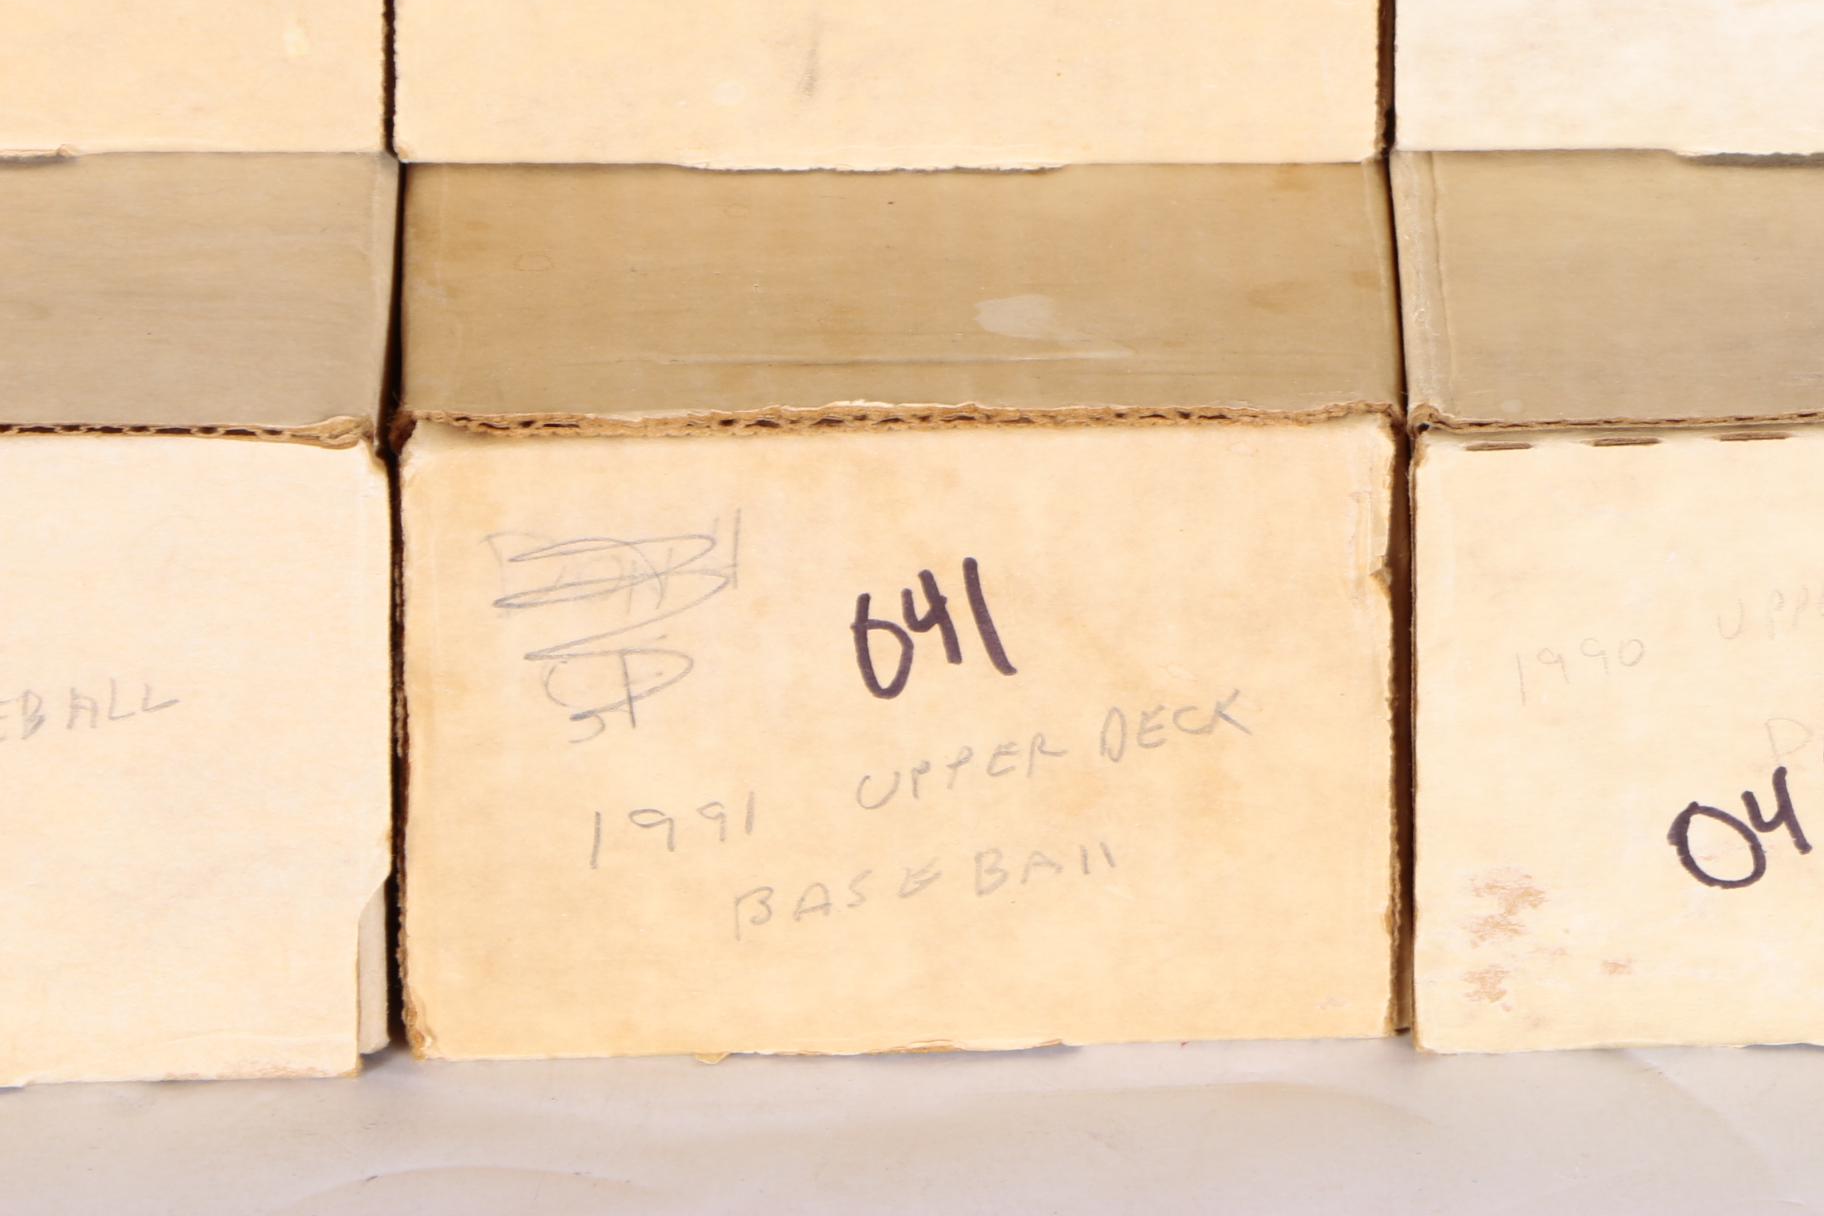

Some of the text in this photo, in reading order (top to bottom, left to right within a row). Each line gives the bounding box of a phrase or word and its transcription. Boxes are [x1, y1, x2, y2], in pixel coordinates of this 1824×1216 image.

[850, 556, 1018, 700] 041
[1513, 634, 1646, 706] 1990
[590, 688, 1253, 871] 1991 UPPER DECK
